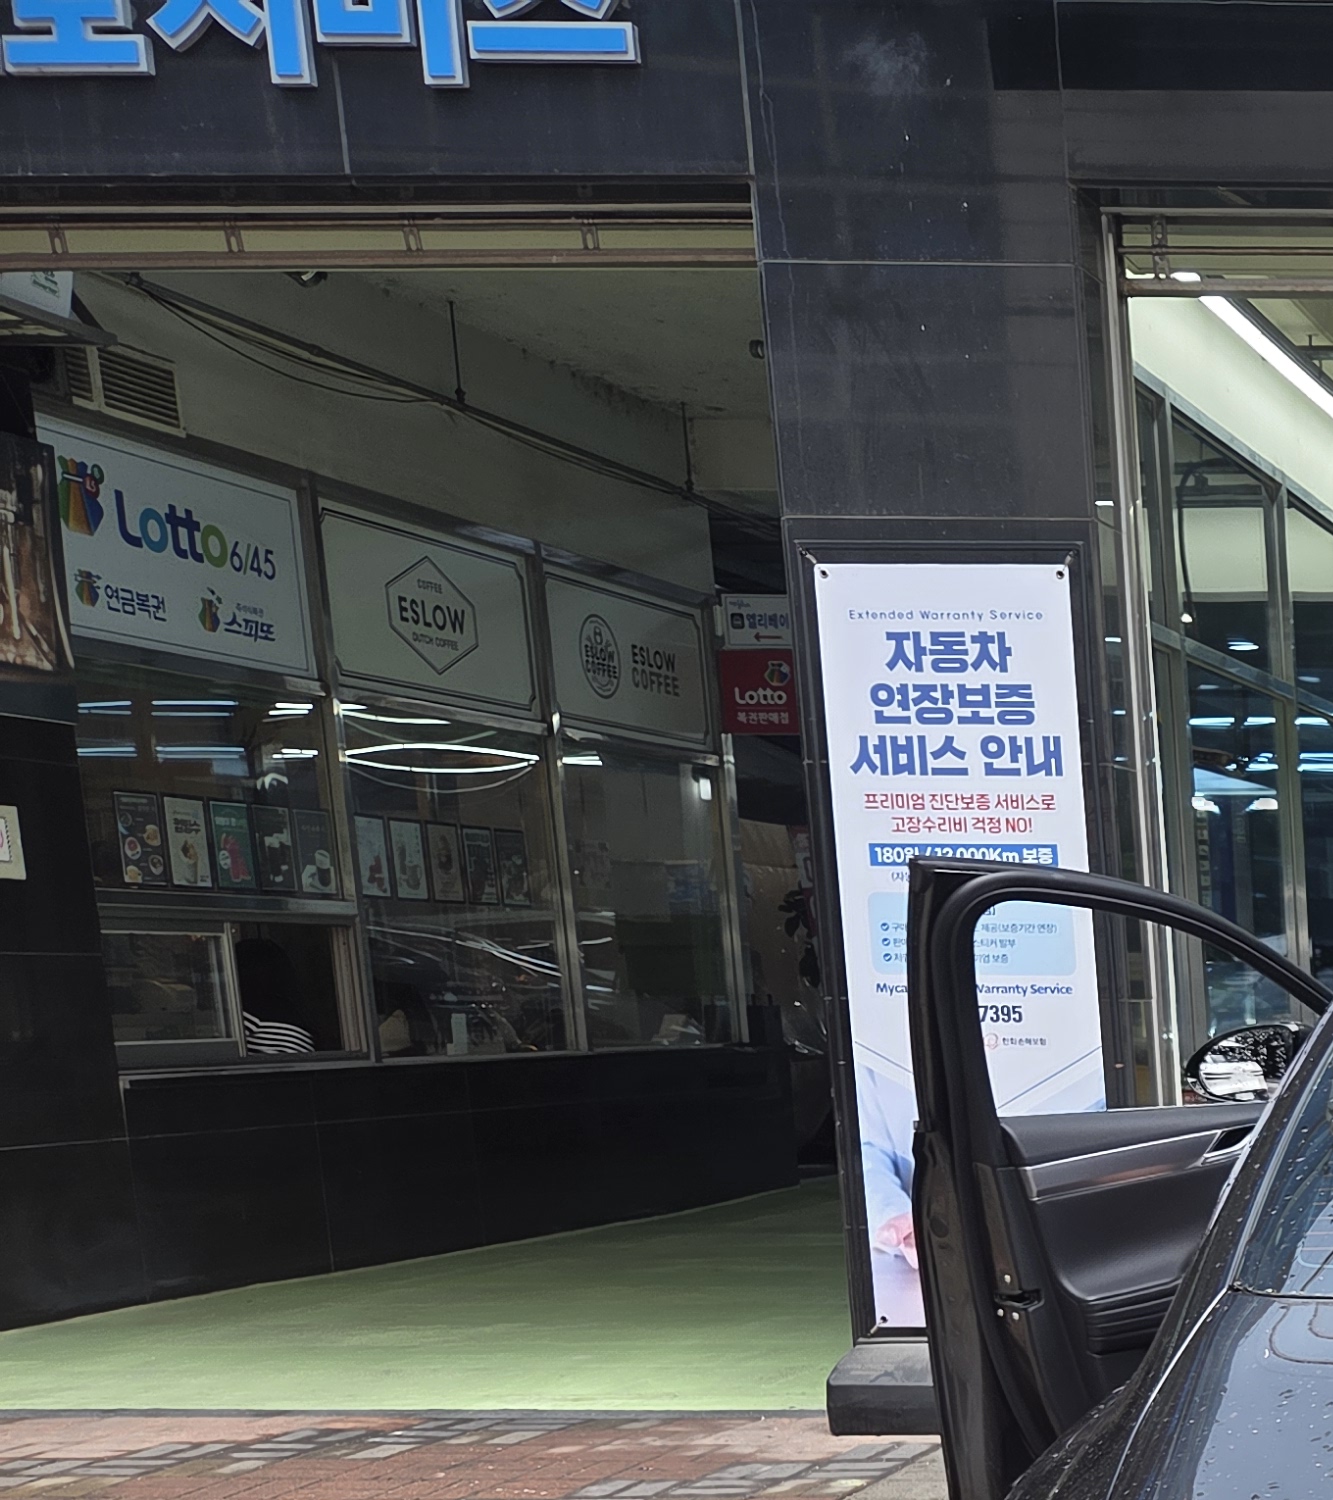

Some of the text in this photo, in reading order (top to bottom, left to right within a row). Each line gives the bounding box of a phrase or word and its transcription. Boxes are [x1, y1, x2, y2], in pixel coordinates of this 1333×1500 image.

[114, 489, 276, 581] Lotto 6/45
[417, 578, 443, 595] COFFEE
[104, 583, 167, 622] 연금복권
[397, 595, 465, 635] ESLOW
[848, 609, 1044, 622] Extended Warranty Service
[223, 611, 276, 642] 스피또
[412, 631, 459, 652] DUTCH COFFEE
[884, 630, 1013, 674] 자동차
[584, 644, 615, 665] ESLOW
[631, 644, 676, 673] ESLOW
[585, 658, 618, 679] COFFEE
[631, 667, 680, 697] COFFEE
[734, 687, 788, 705] Lotto
[869, 683, 1036, 726] 연장보증
[849, 734, 1065, 777] 서비스 안내
[863, 793, 1057, 811] 프리미엄 진단보증 서비스로
[890, 817, 1033, 834] 고장수리비 걱정 NO!
[934, 846, 1020, 863] 12000Km
[1022, 847, 1054, 866] 보증
[1030, 983, 1073, 995] Service
